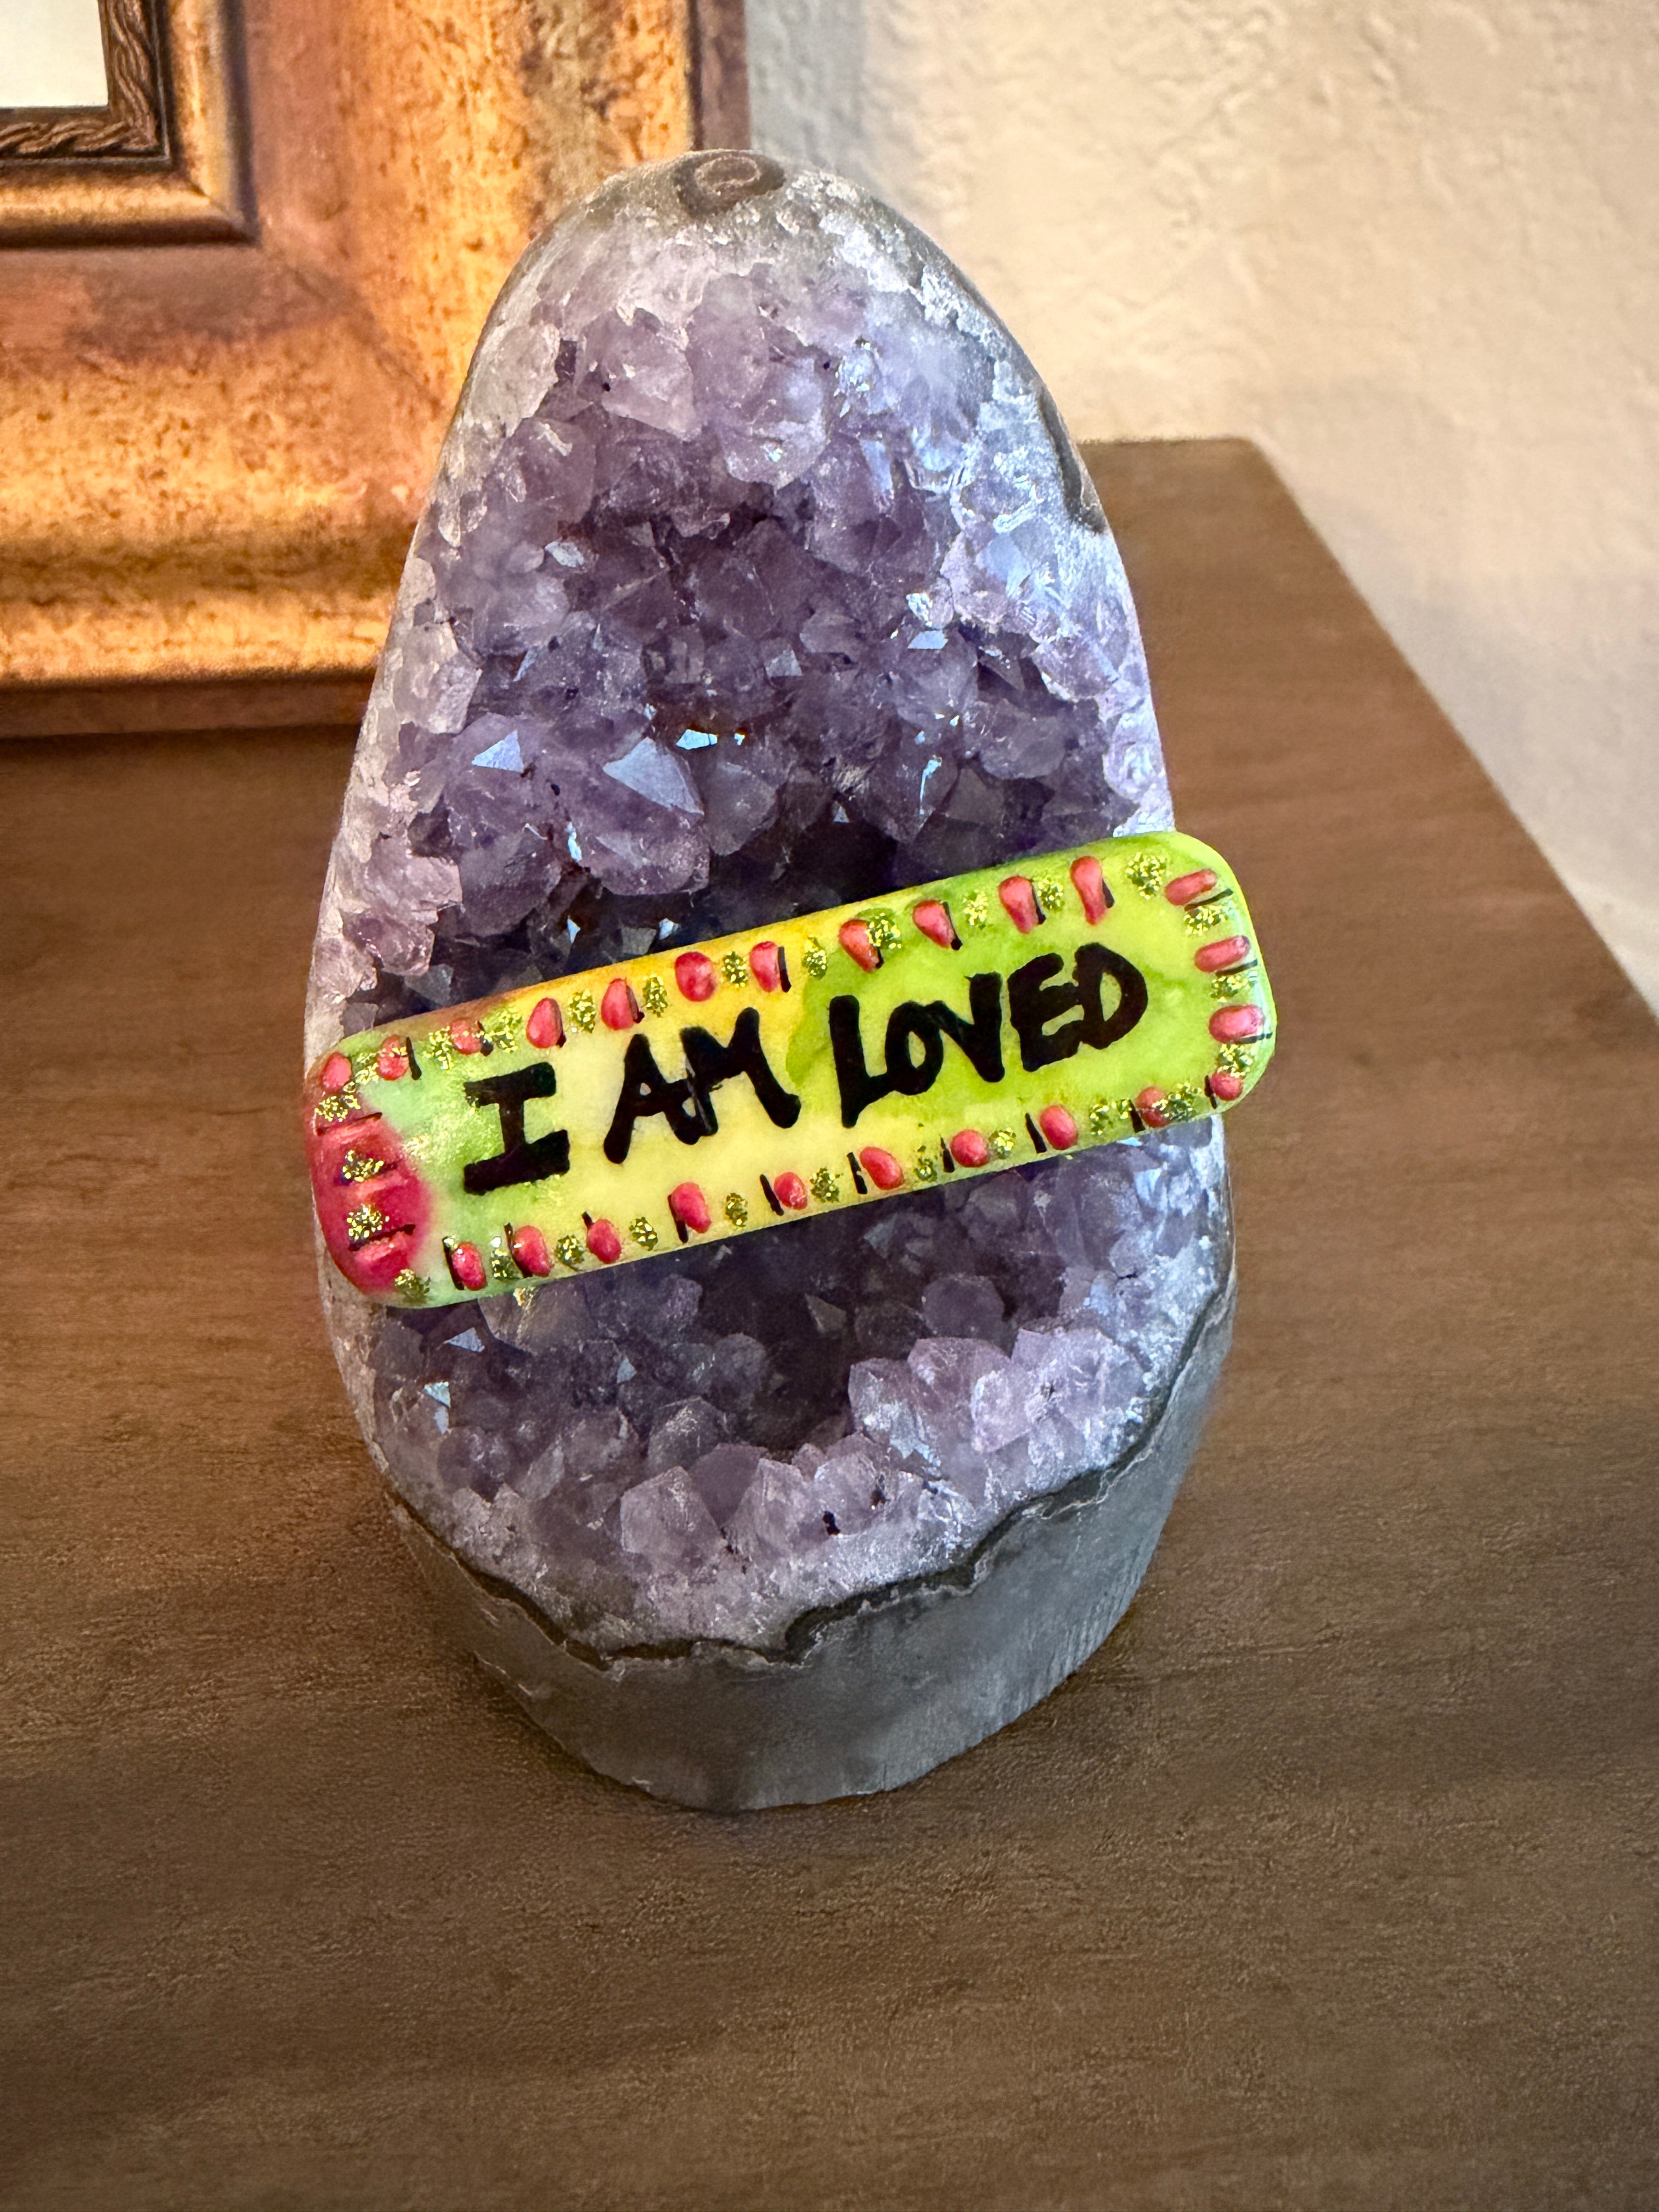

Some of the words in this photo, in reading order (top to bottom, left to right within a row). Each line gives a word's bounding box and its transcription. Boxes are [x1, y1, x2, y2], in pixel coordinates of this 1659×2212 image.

[463, 1062, 570, 1196] I
[603, 1007, 802, 1164] AM
[828, 943, 1148, 1128] LOVED
